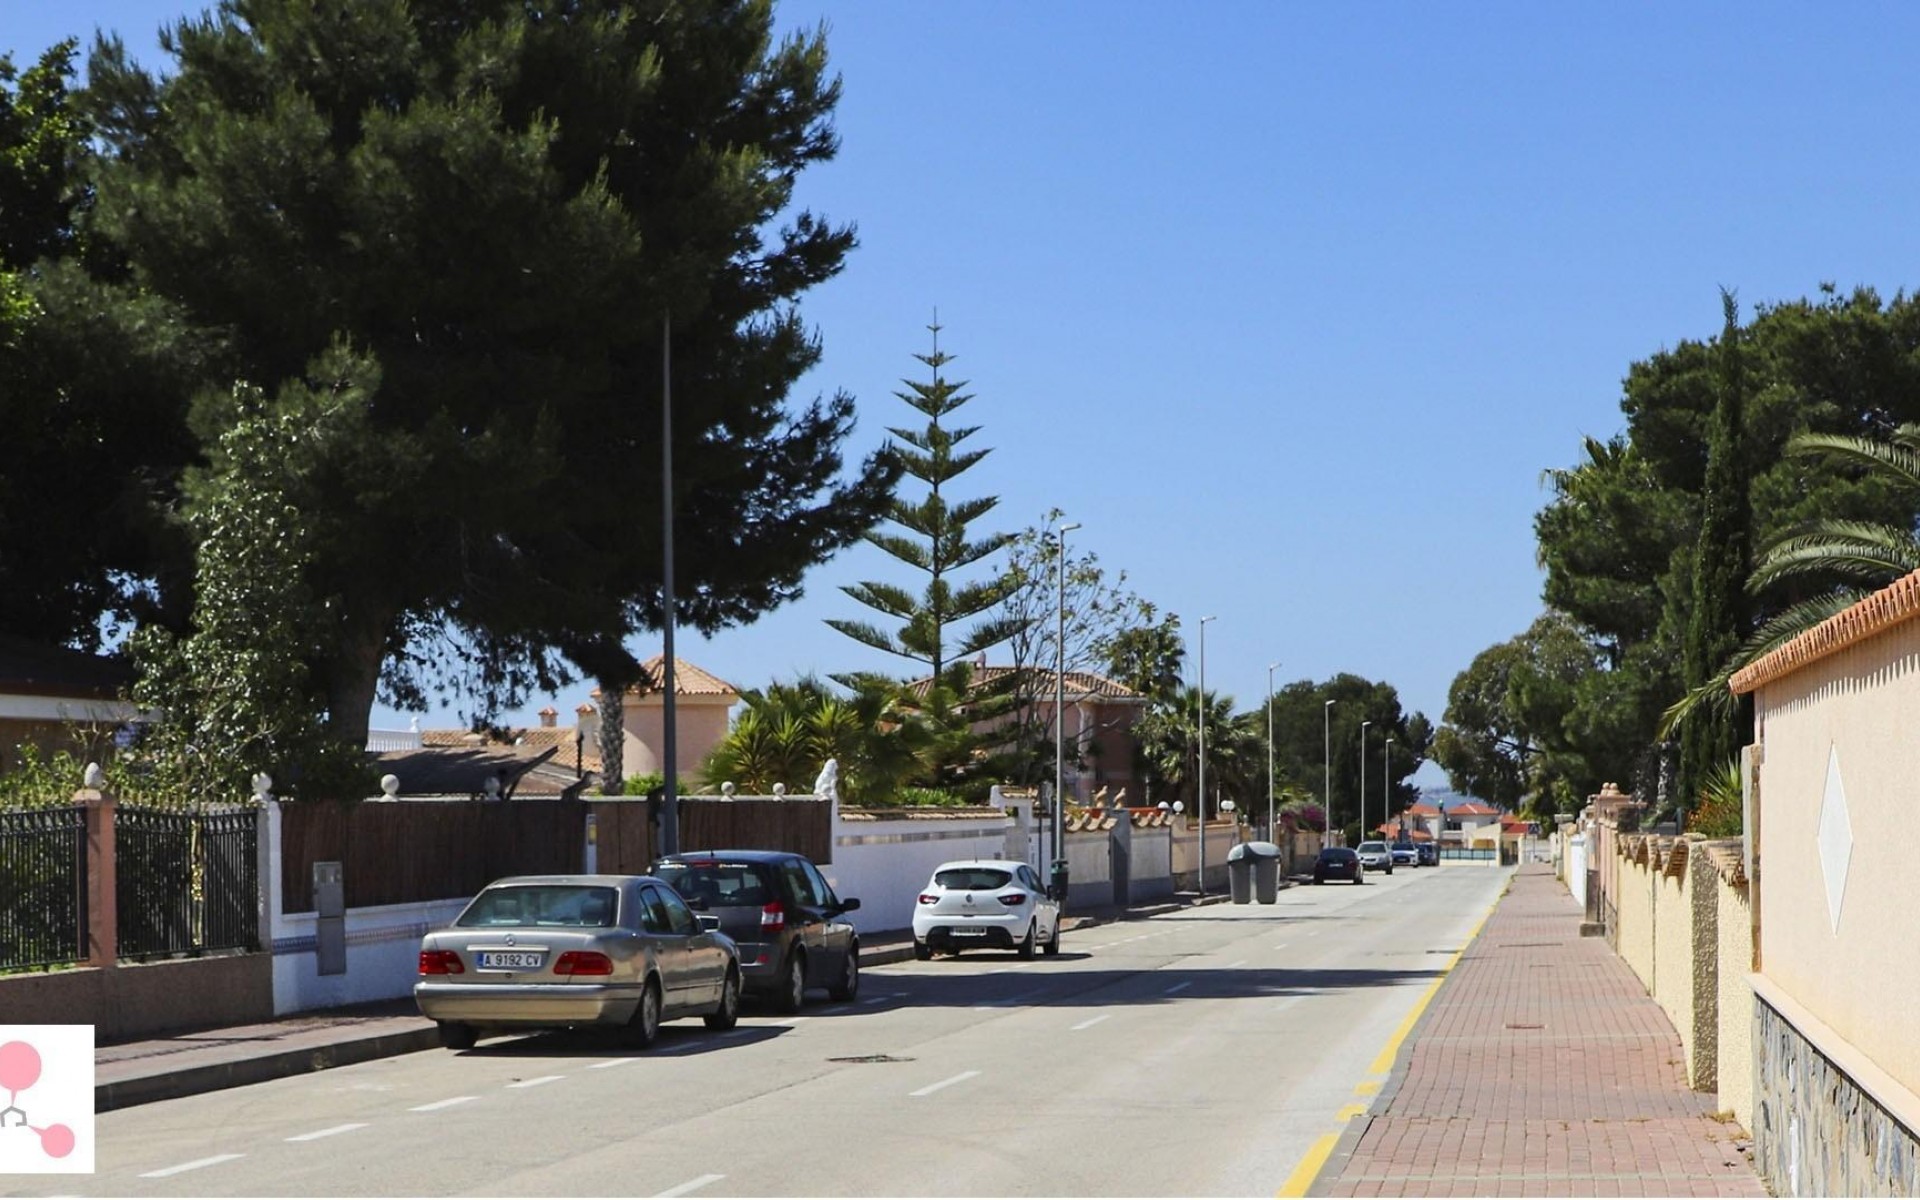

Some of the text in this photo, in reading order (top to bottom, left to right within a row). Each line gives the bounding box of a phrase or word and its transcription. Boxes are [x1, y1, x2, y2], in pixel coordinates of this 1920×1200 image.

[485, 954, 540, 966] A 9192 CV
